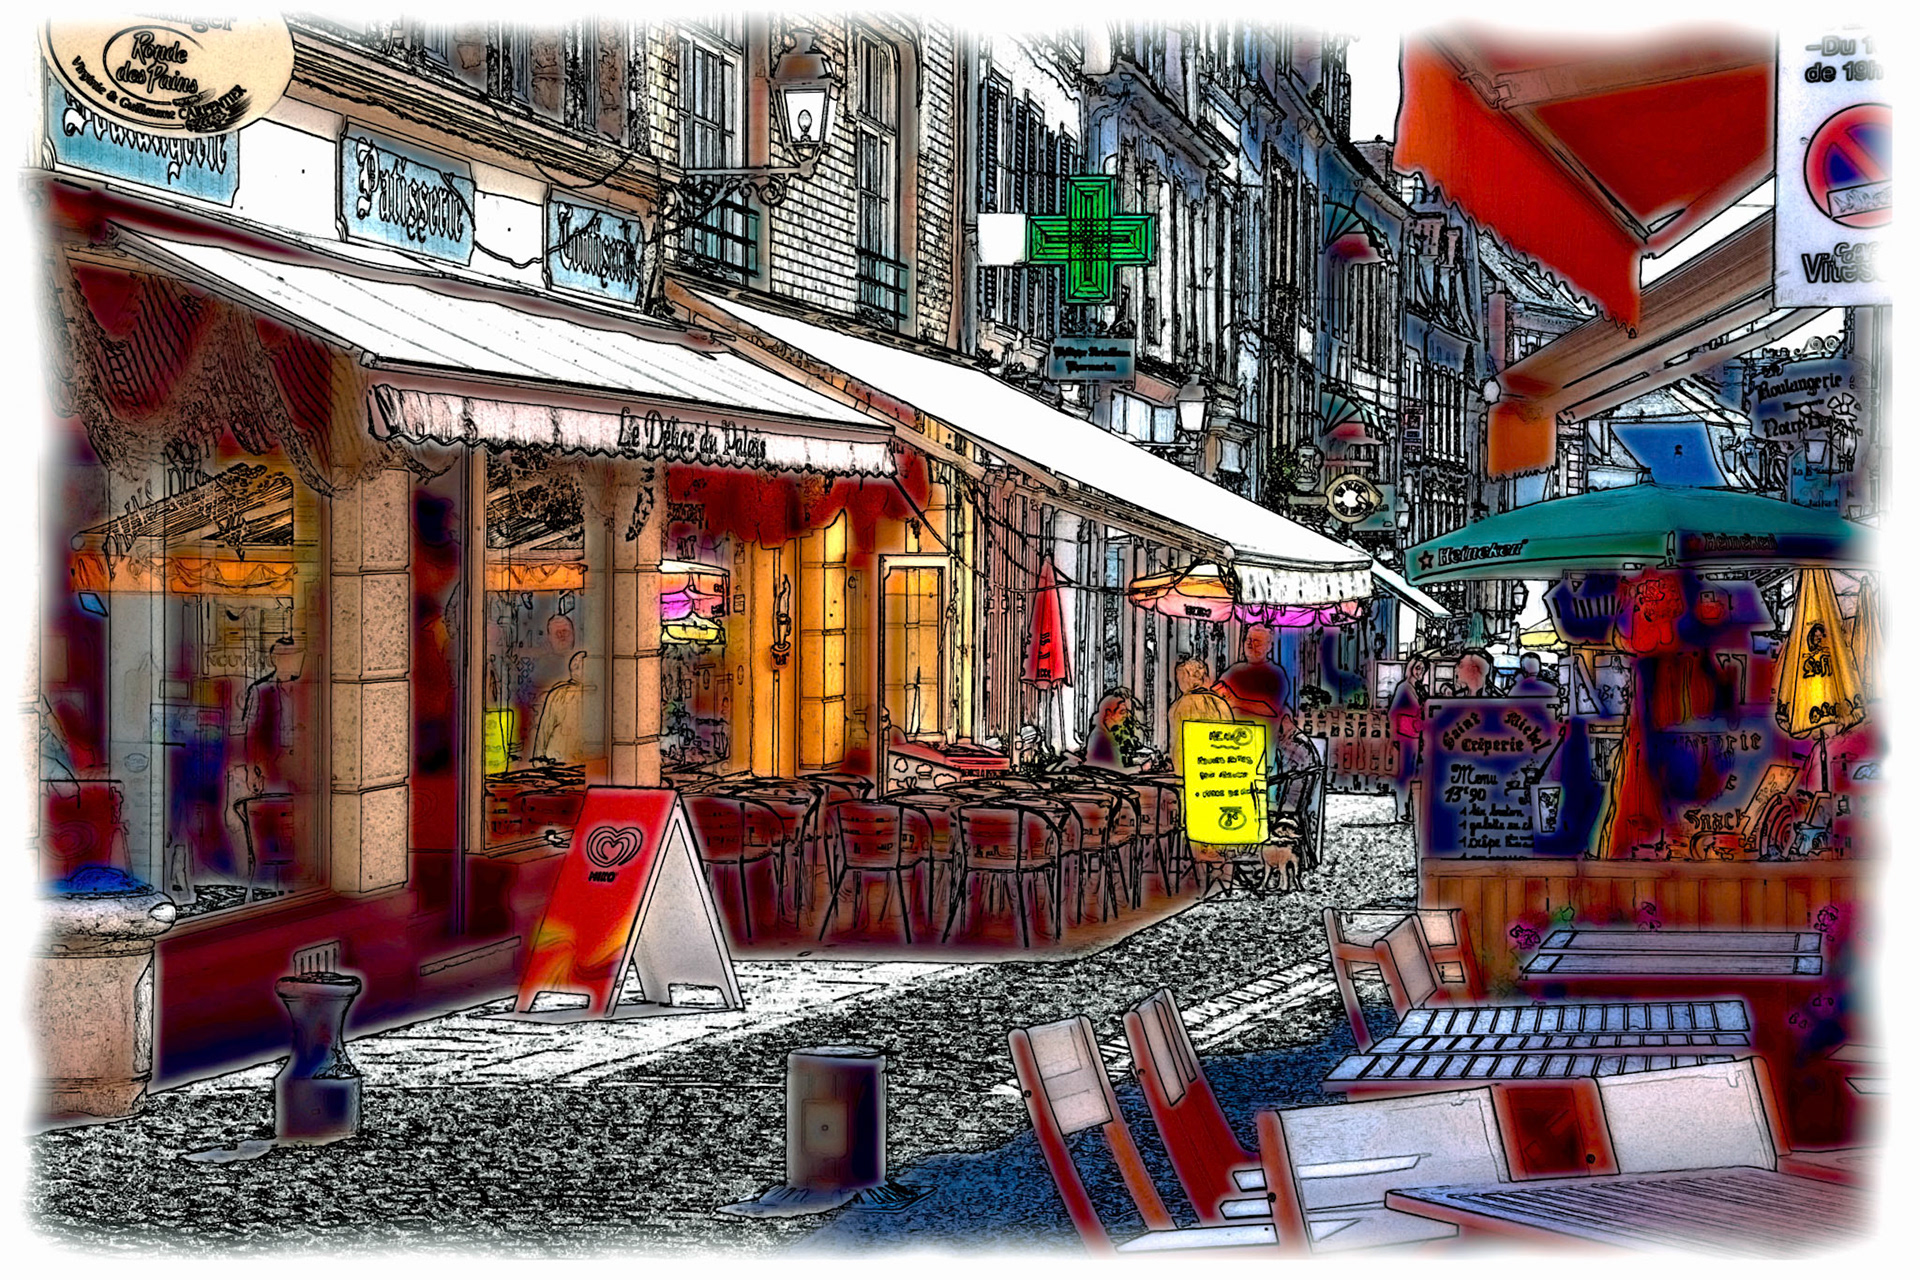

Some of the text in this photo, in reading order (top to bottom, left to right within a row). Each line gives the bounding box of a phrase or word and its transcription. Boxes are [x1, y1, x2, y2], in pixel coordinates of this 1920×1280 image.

[132, 31, 188, 65] Ronde
[116, 61, 198, 93] des Pains
[1804, 61, 1837, 83] de
[1801, 252, 1888, 284] Vites
[1438, 542, 1523, 566] Heineken
[1442, 712, 1481, 751] Saint
[1450, 763, 1498, 785] Menu
